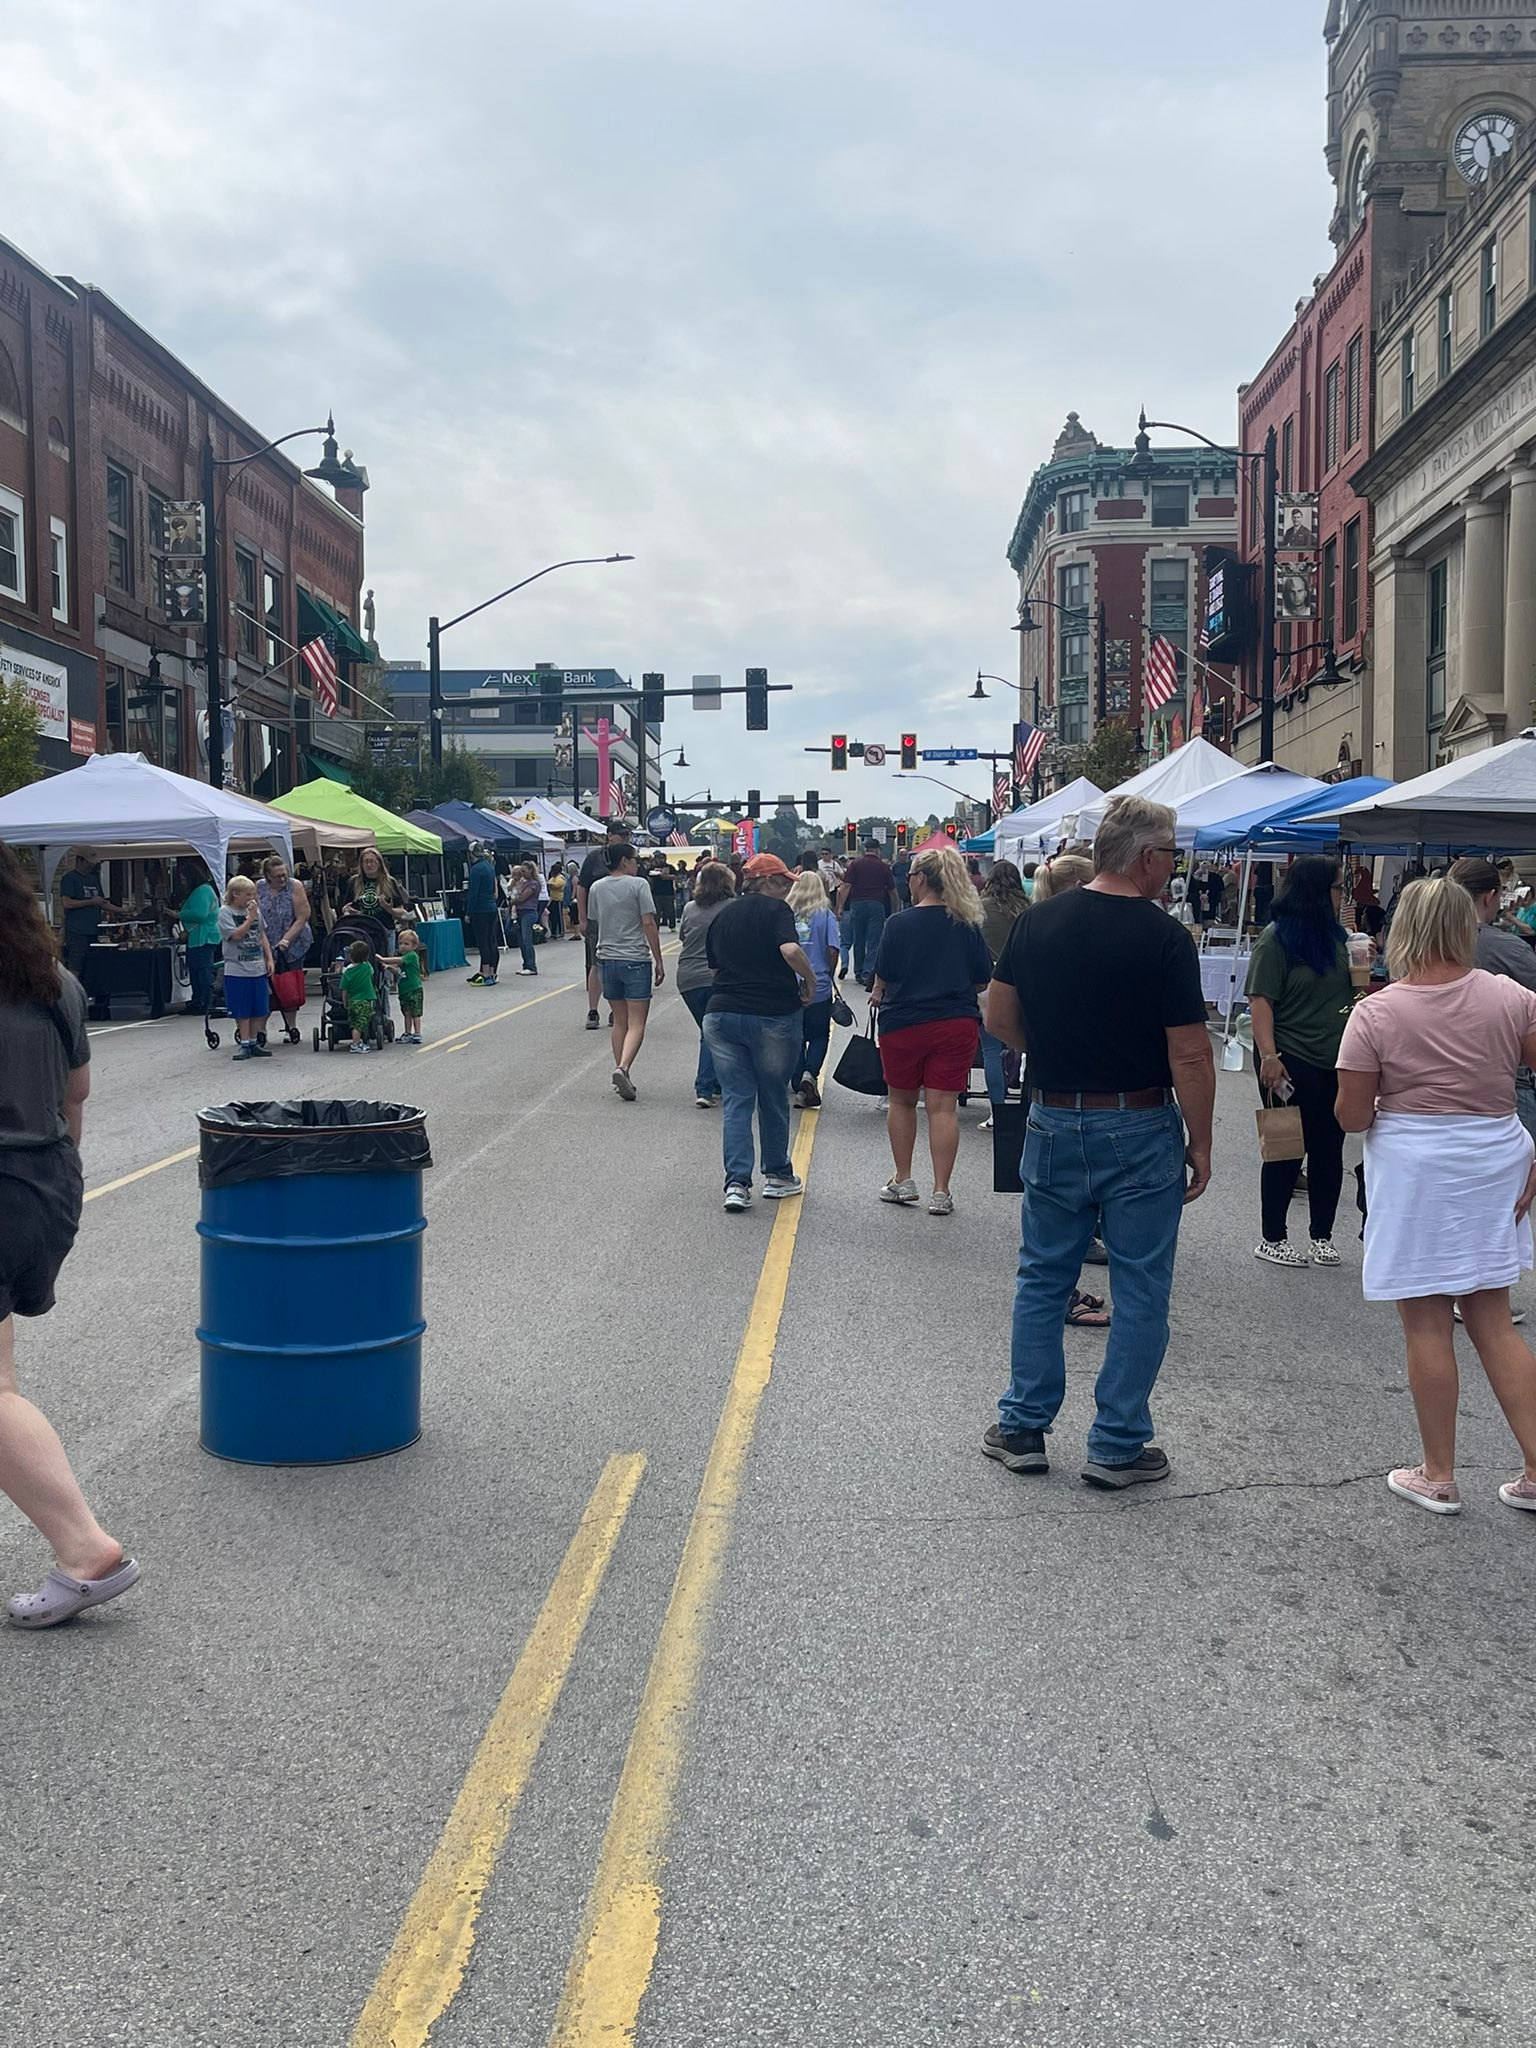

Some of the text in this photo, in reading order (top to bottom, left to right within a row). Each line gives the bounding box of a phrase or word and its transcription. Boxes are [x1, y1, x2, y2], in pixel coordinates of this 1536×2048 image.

[1432, 371, 1536, 484] FARMERS NATIONAL BA
[13, 662, 35, 681] SERVICES
[34, 670, 42, 683] OF
[42, 672, 61, 688] AMERICA
[563, 671, 596, 684] Bank
[932, 750, 956, 758] Diamond
